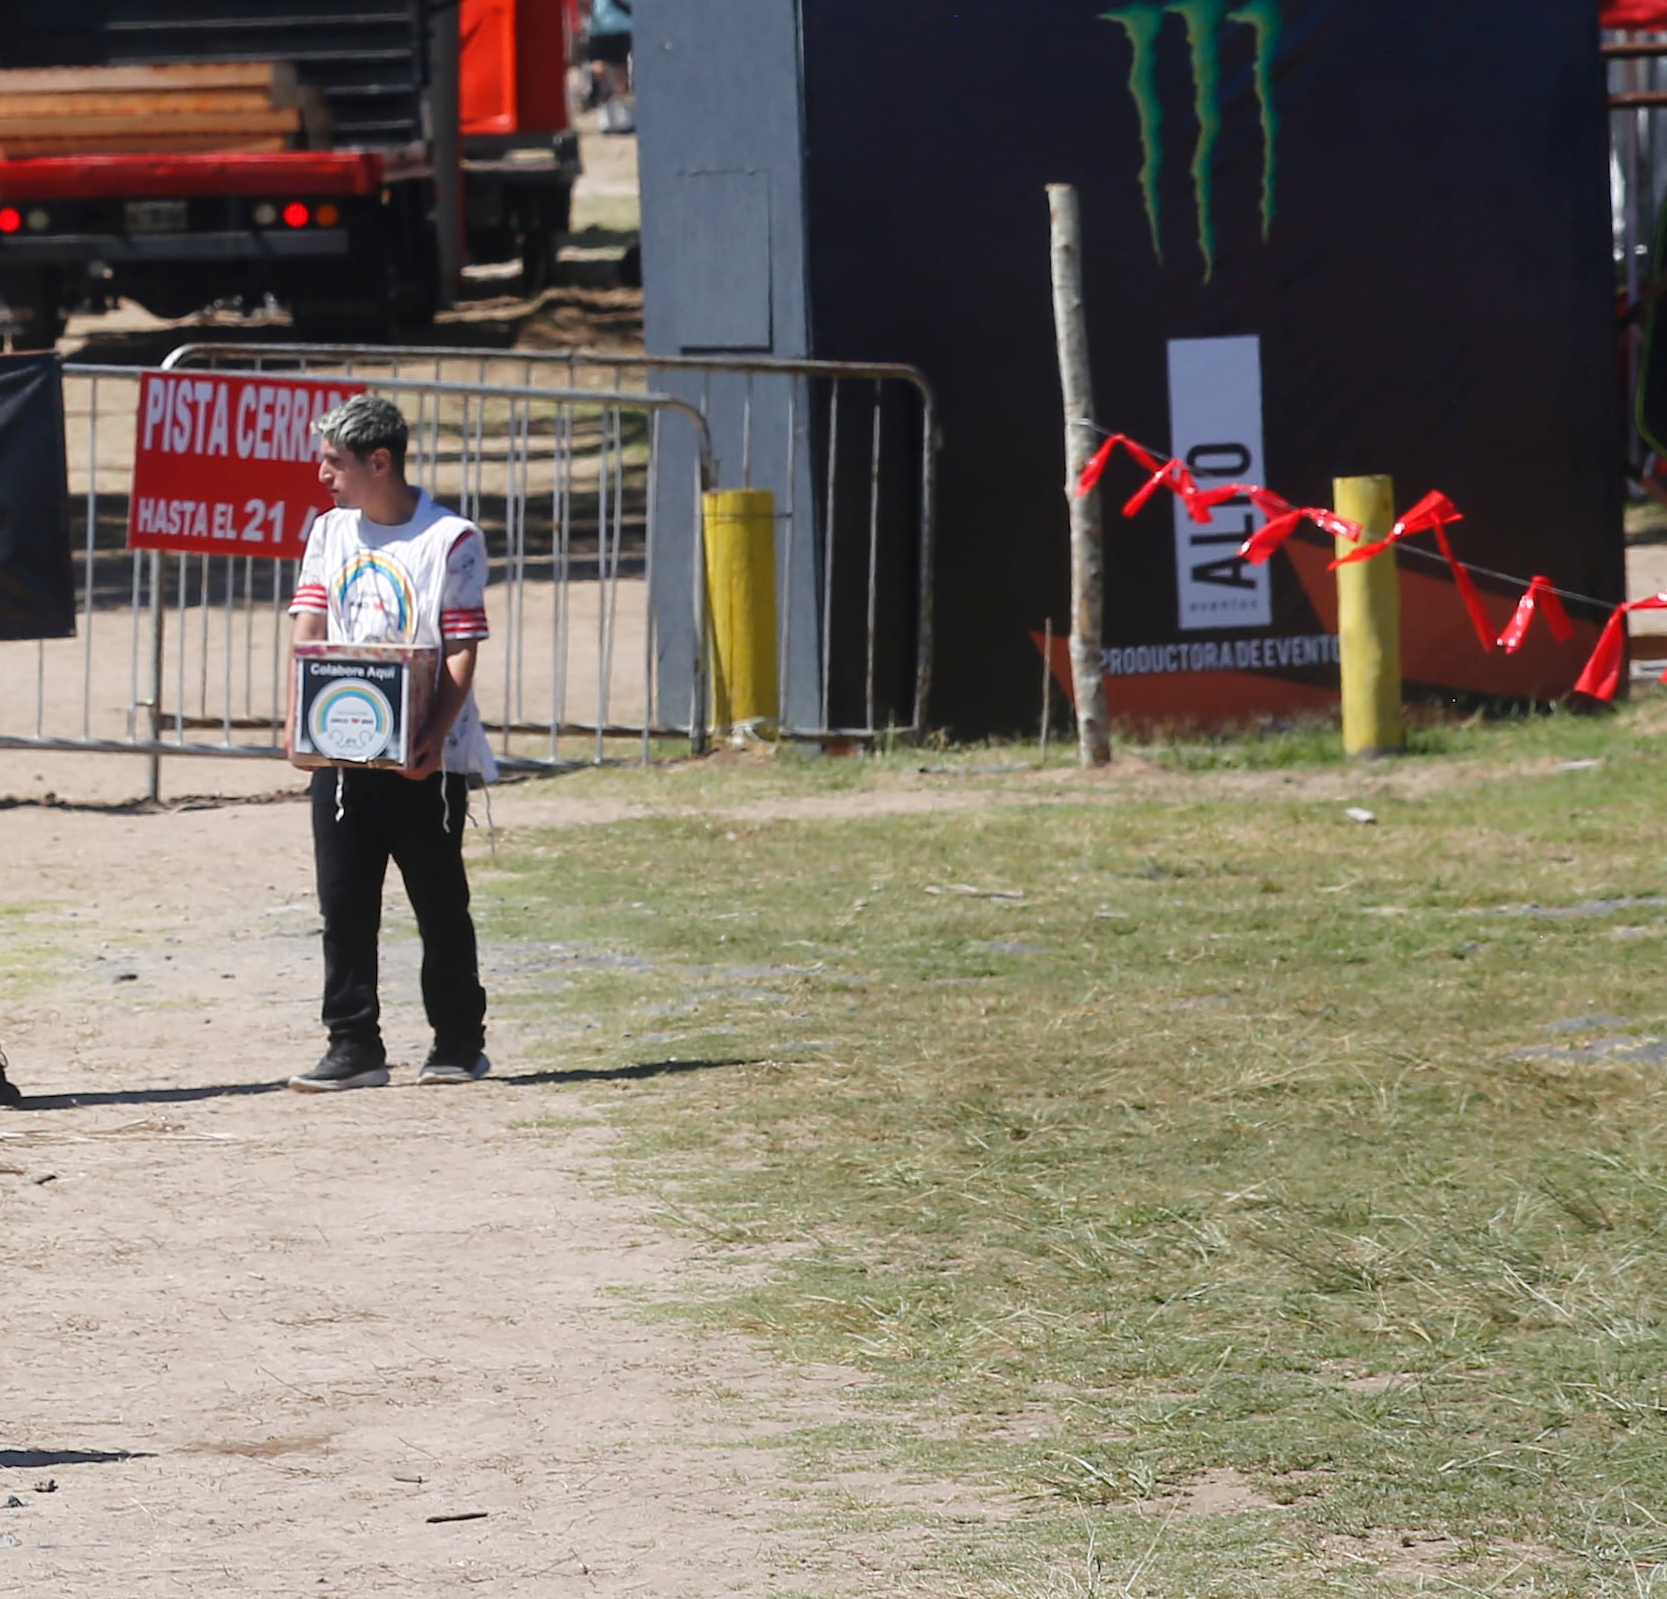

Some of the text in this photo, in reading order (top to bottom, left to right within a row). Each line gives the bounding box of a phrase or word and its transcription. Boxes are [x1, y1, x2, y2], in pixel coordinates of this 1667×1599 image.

[142, 377, 229, 457] PISTA
[137, 498, 208, 537] HASTA
[211, 502, 237, 539] EL
[240, 498, 286, 543] 21
[309, 663, 365, 677] Colabore
[1236, 640, 1263, 667] DE
